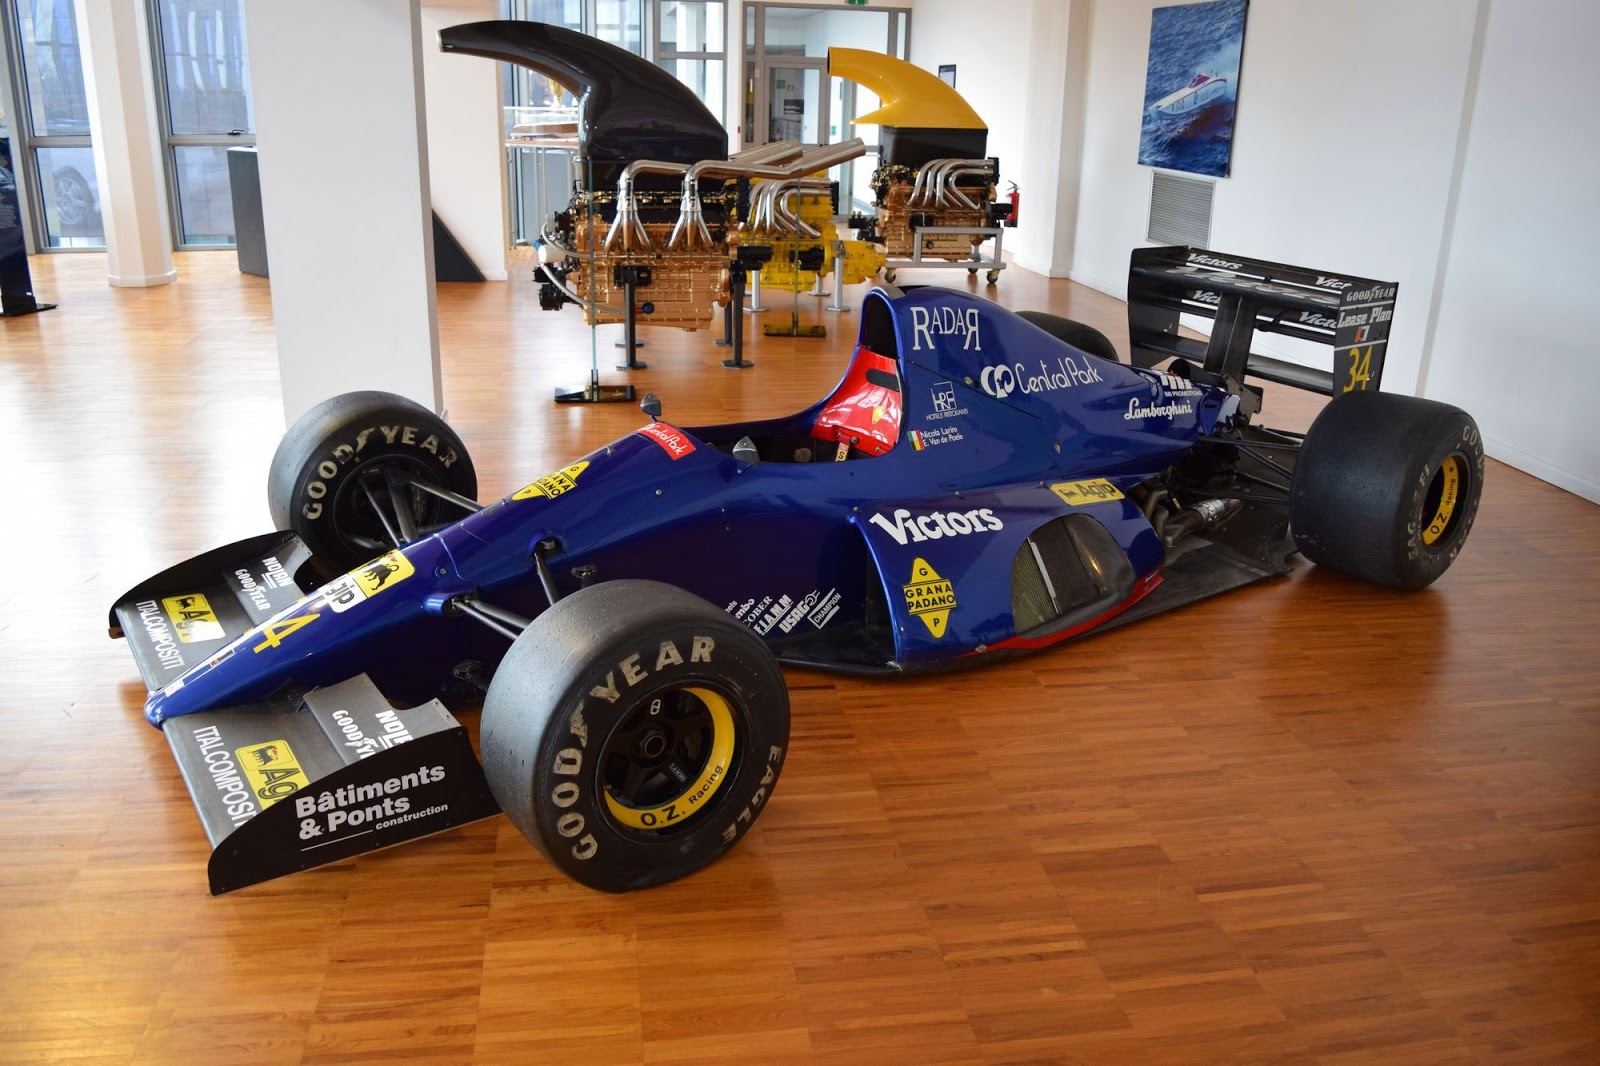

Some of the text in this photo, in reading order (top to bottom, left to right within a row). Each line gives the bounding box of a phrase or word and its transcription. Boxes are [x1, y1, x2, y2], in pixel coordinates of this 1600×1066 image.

[1187, 253, 1243, 270] Victors
[1337, 306, 1393, 328] Lease Plan
[1343, 345, 1373, 394] 34
[1124, 397, 1193, 420] Lamborghini
[921, 426, 958, 438] Nicola Larini
[929, 437, 941, 446] Van
[1074, 481, 1116, 499] Agip
[869, 508, 1004, 545] Victors
[919, 567, 928, 576] G
[235, 568, 271, 611] GOODYEAR
[905, 584, 952, 598] GRANA
[907, 595, 955, 610] PADANO
[779, 600, 811, 633] USAG
[813, 593, 841, 623] CHAMPION
[933, 617, 940, 627] P
[136, 600, 185, 670] ITALCOMPOSITI
[333, 710, 379, 759] GOODY
[552, 636, 715, 860] GOODYEAR
[193, 726, 257, 827] ITALCOMPOSI
[258, 768, 301, 802] Ag
[295, 765, 446, 819] Bâtiments
[689, 765, 723, 804] Racing
[722, 745, 782, 844] EAGLE
[299, 796, 411, 840] & Ponts
[375, 803, 449, 831] construction
